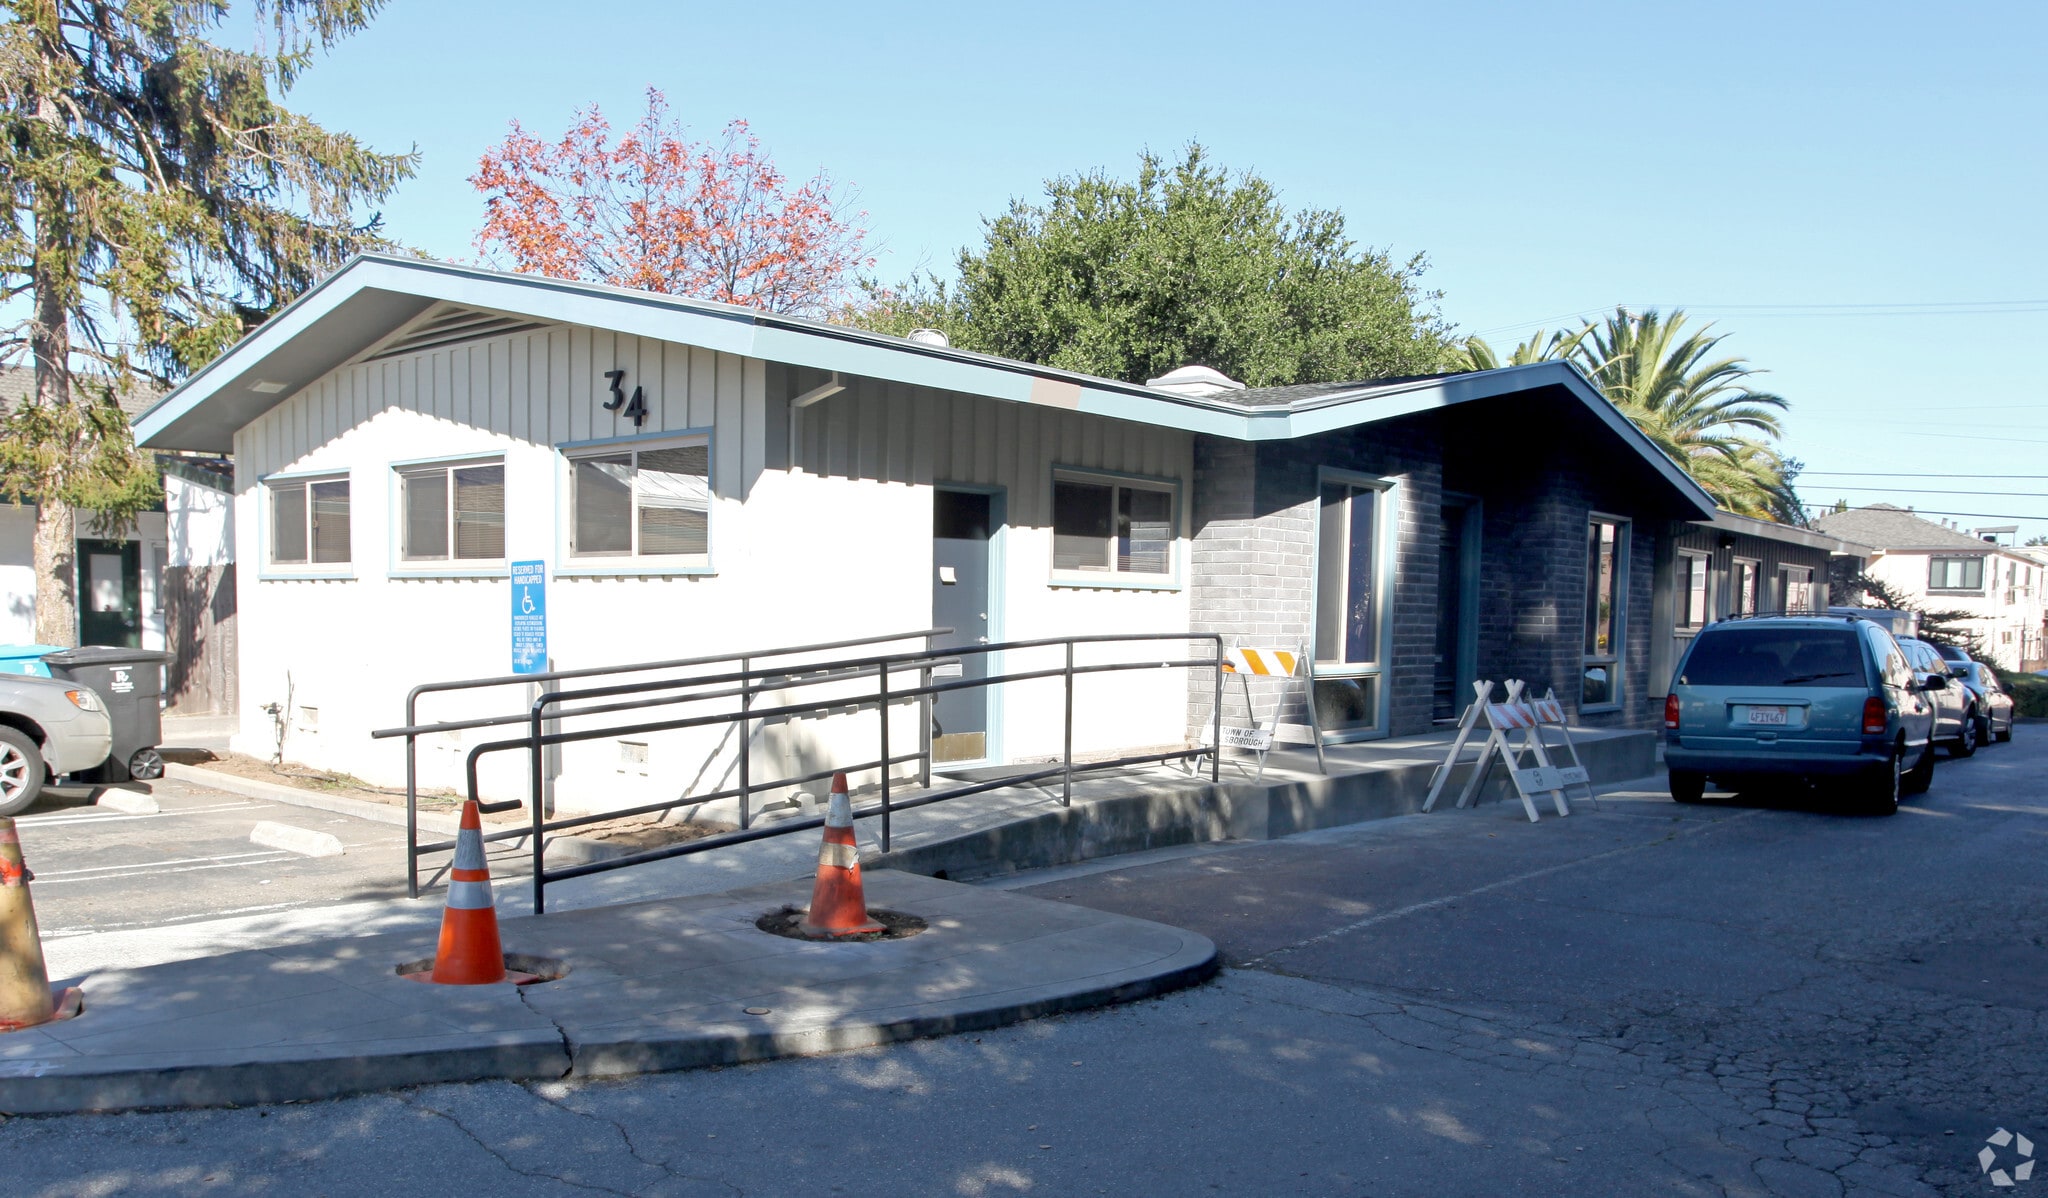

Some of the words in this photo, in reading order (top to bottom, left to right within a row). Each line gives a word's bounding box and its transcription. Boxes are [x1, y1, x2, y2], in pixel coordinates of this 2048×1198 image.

[603, 370, 647, 426] 34
[512, 566, 534, 575] RESERVED
[535, 565, 544, 574] FOR
[514, 575, 542, 584] HANDICAPPED
[1222, 727, 1242, 736] TOWN
[1244, 729, 1255, 738] OF
